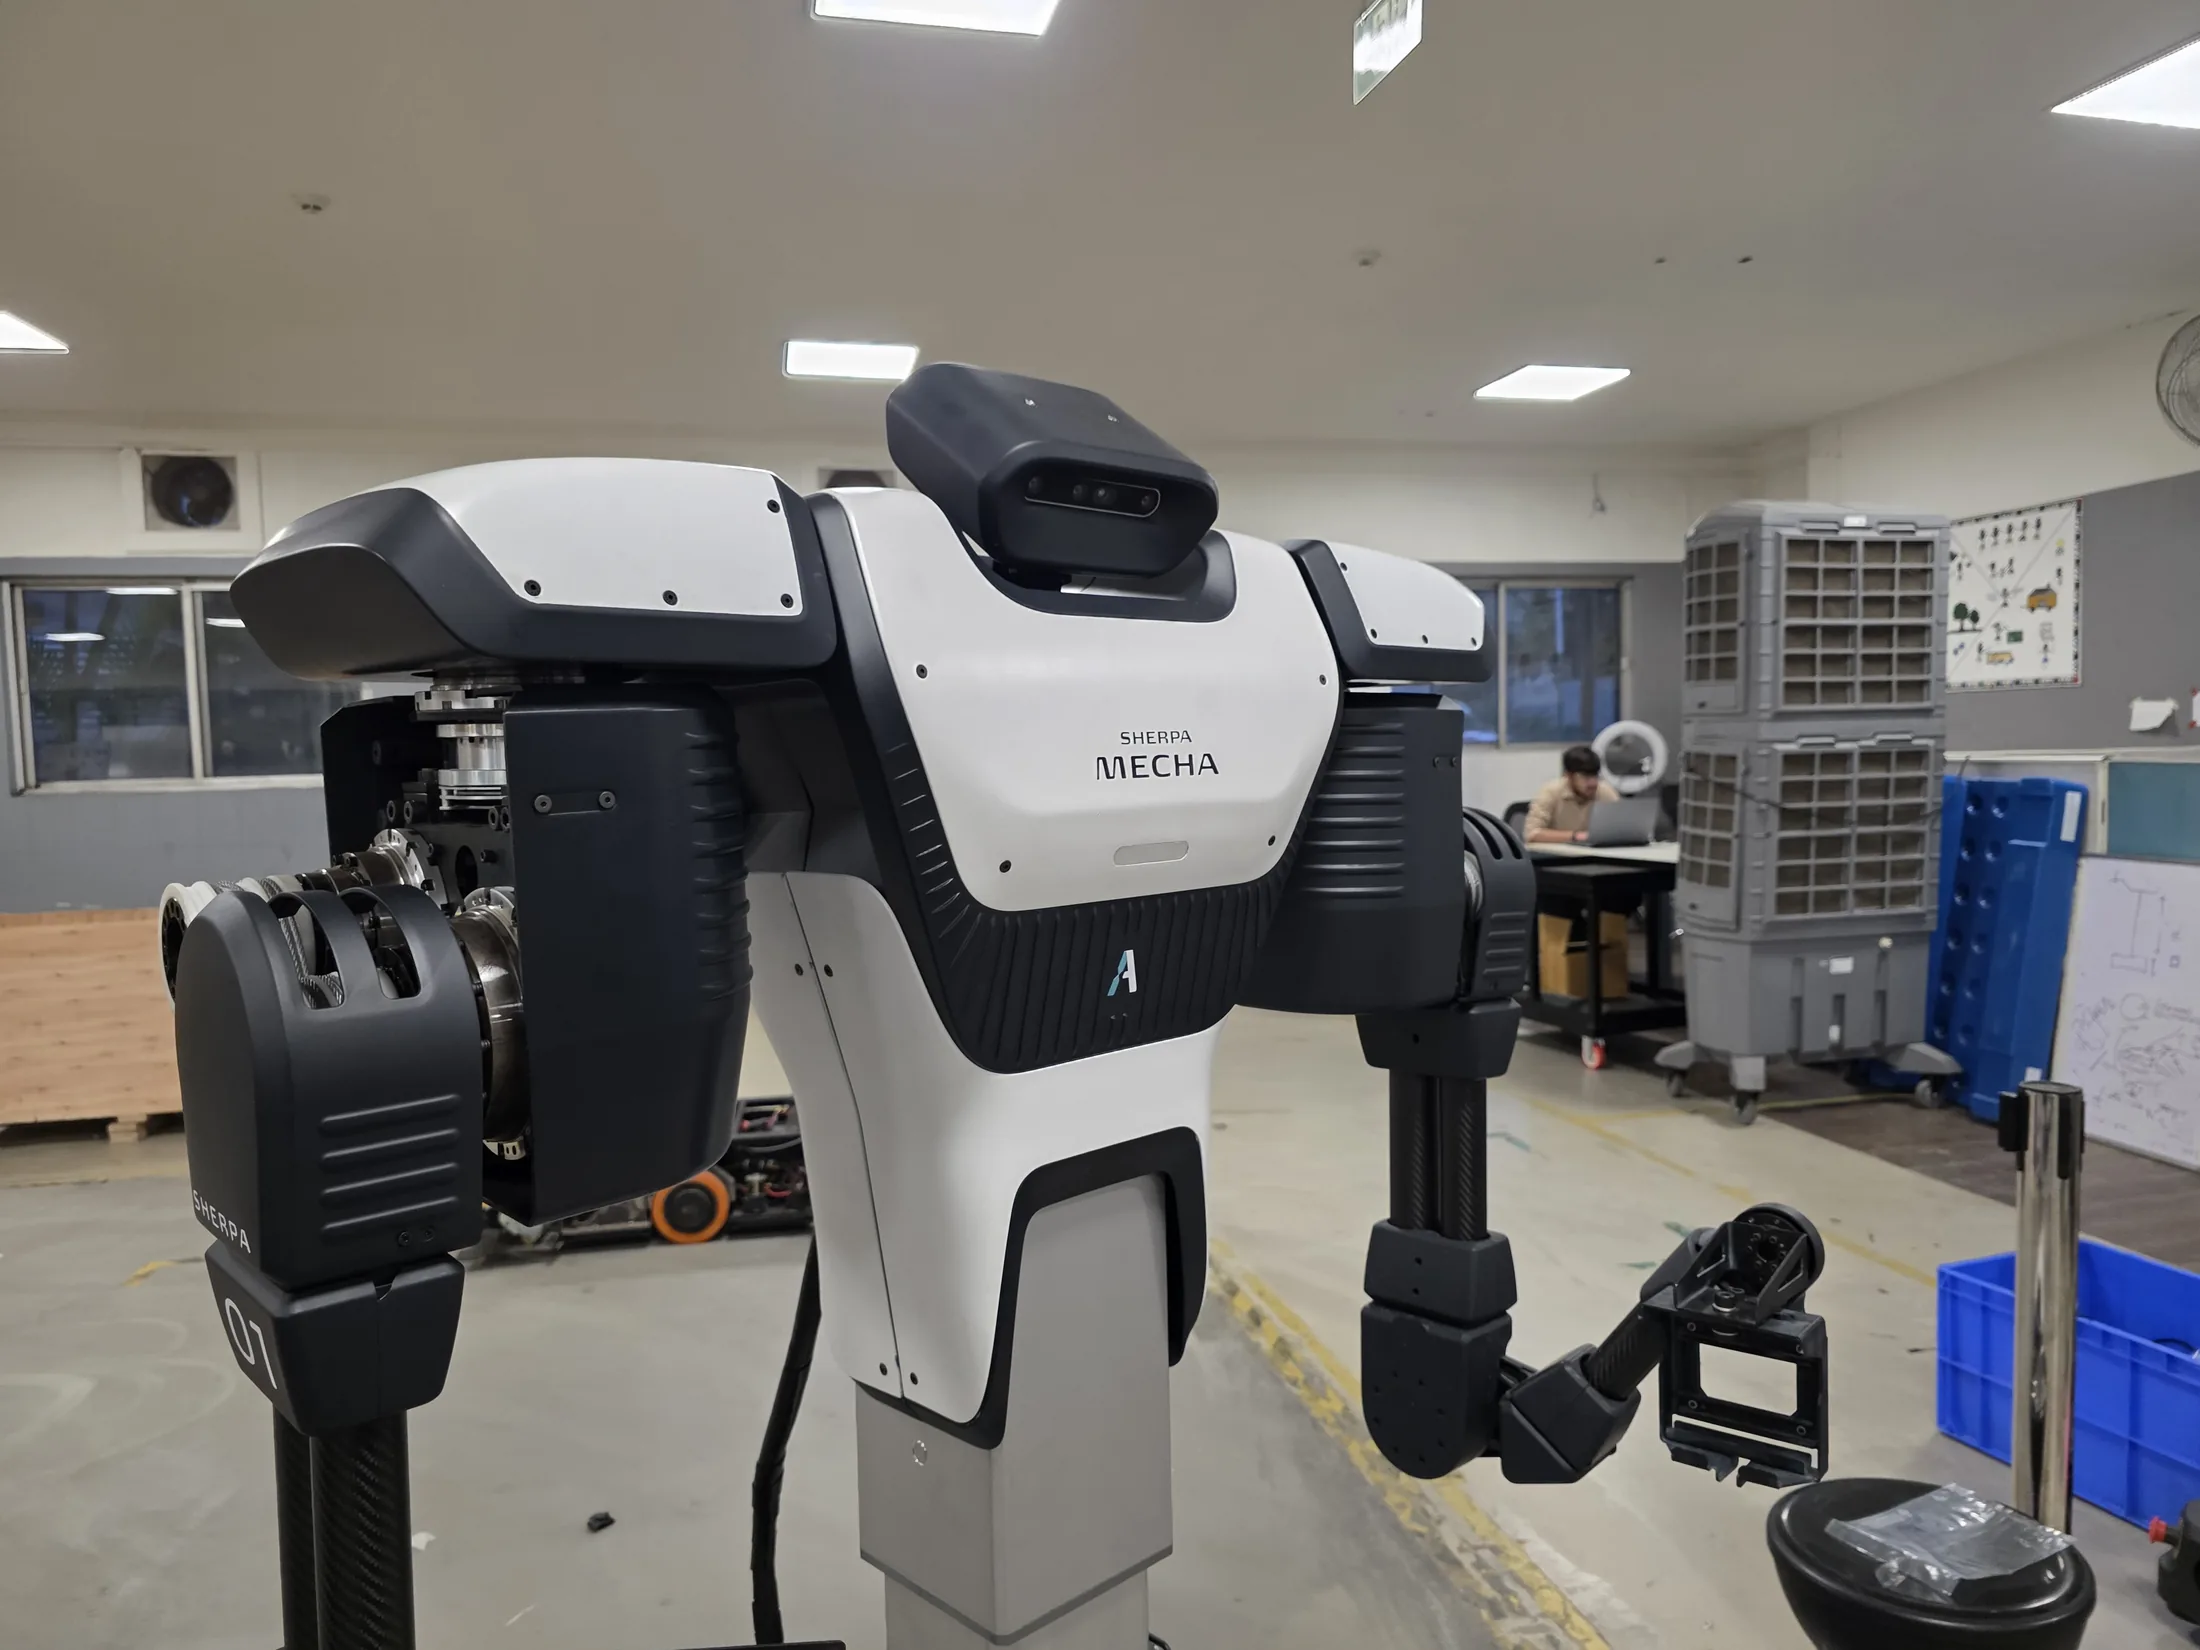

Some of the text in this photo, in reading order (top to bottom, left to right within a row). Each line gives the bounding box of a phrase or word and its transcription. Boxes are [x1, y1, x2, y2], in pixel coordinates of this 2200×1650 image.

[1120, 730, 1193, 745] SHERPA
[1096, 753, 1219, 780] MECHA
[193, 1189, 251, 1254] SHERPA
[225, 1297, 278, 1390] 01
